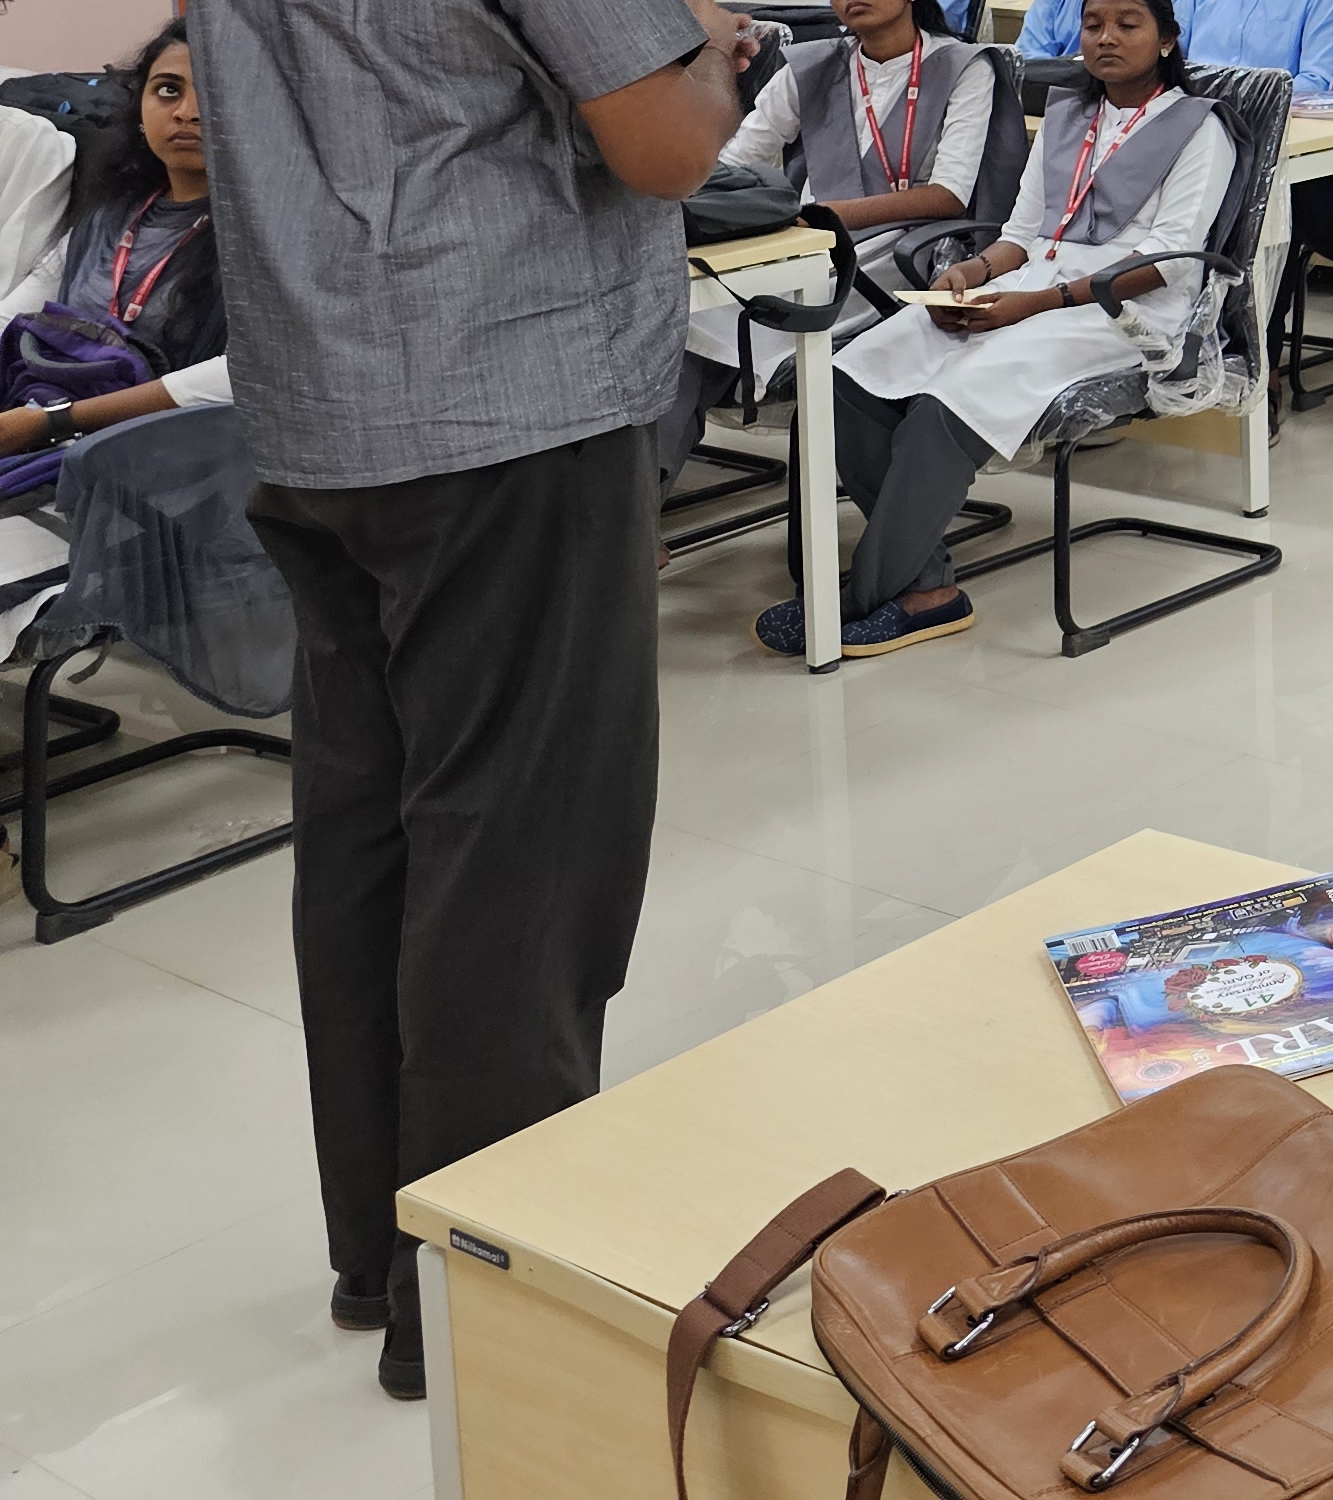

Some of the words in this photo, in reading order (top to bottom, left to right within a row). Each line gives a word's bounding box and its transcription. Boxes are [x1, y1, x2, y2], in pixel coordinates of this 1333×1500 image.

[1217, 979, 1285, 998] Anniversary
[1244, 993, 1275, 1007] 41
[461, 1238, 499, 1263] Nilkamal
